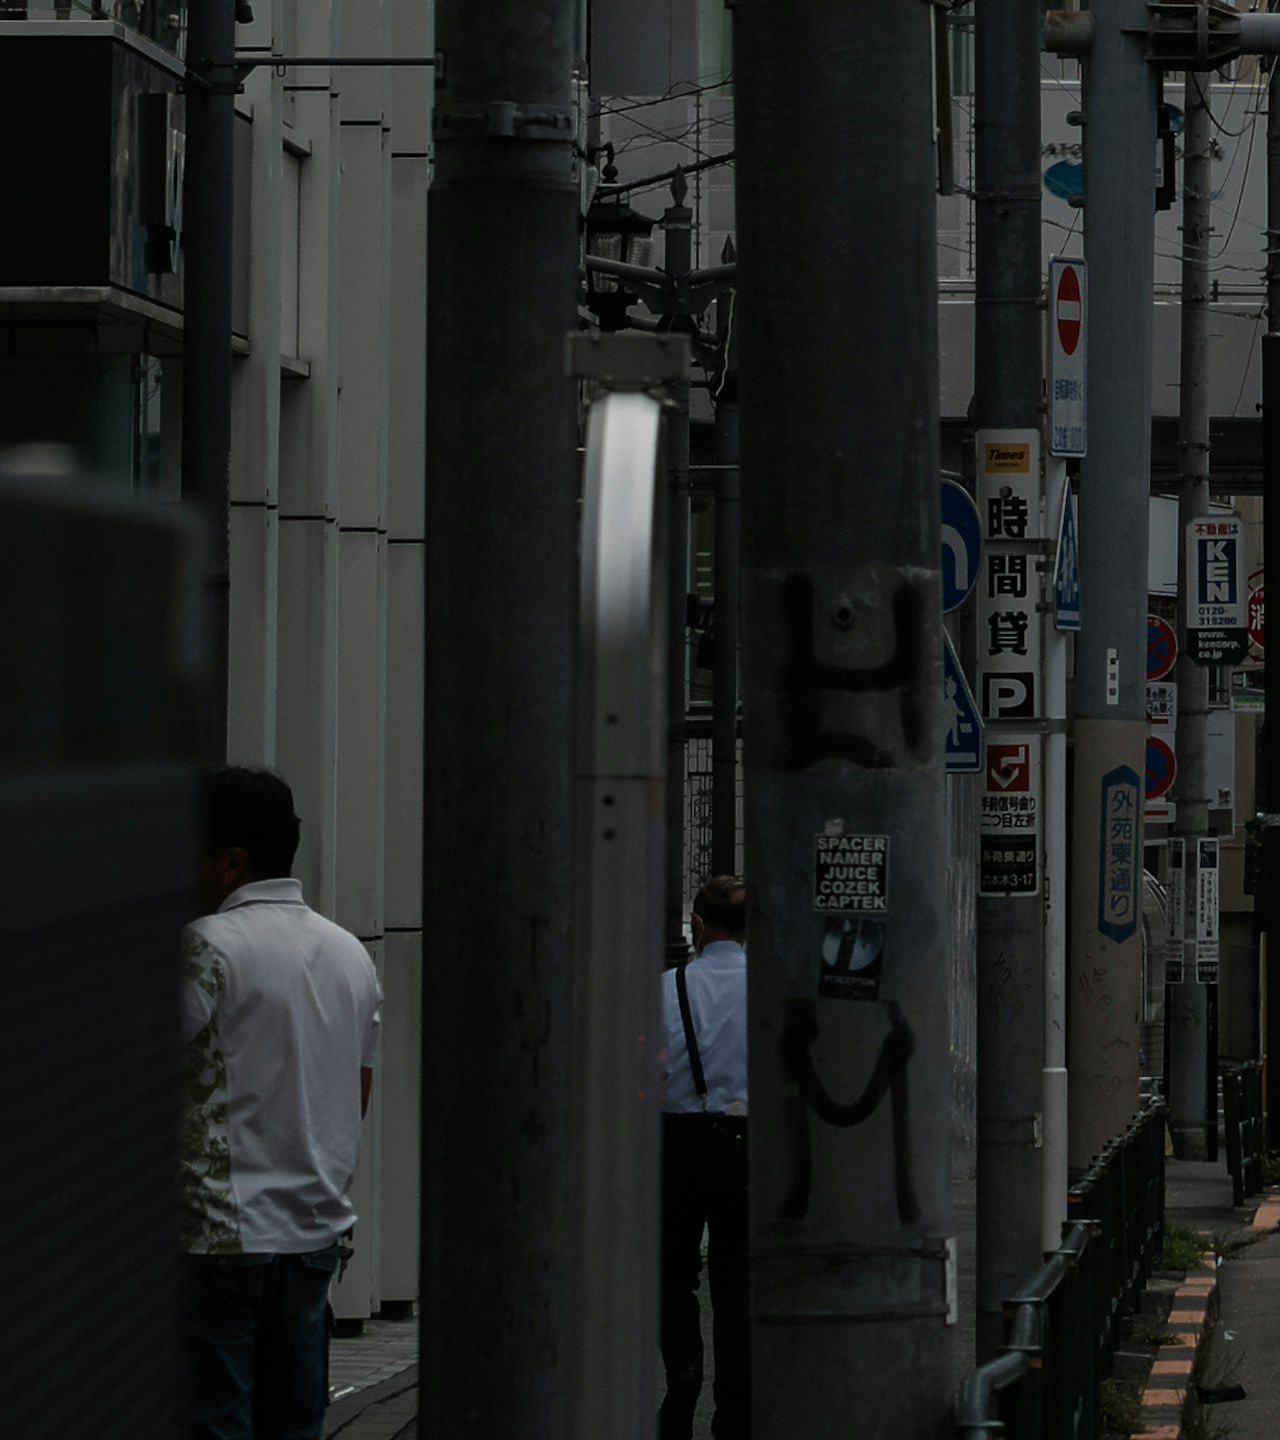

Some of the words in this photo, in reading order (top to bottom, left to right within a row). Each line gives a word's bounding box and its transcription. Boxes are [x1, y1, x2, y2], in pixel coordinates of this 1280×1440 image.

[988, 448, 1025, 462] Times
[987, 495, 1029, 657] 時間貸
[1205, 540, 1230, 604] KEN
[988, 677, 1028, 718] P
[816, 836, 886, 852] SPACER
[818, 851, 884, 866] NAMER
[1109, 789, 1134, 917] 外苑東通り
[823, 866, 879, 880] JUICE
[819, 880, 881, 895] COZEK
[815, 895, 886, 910] CAPTEK
